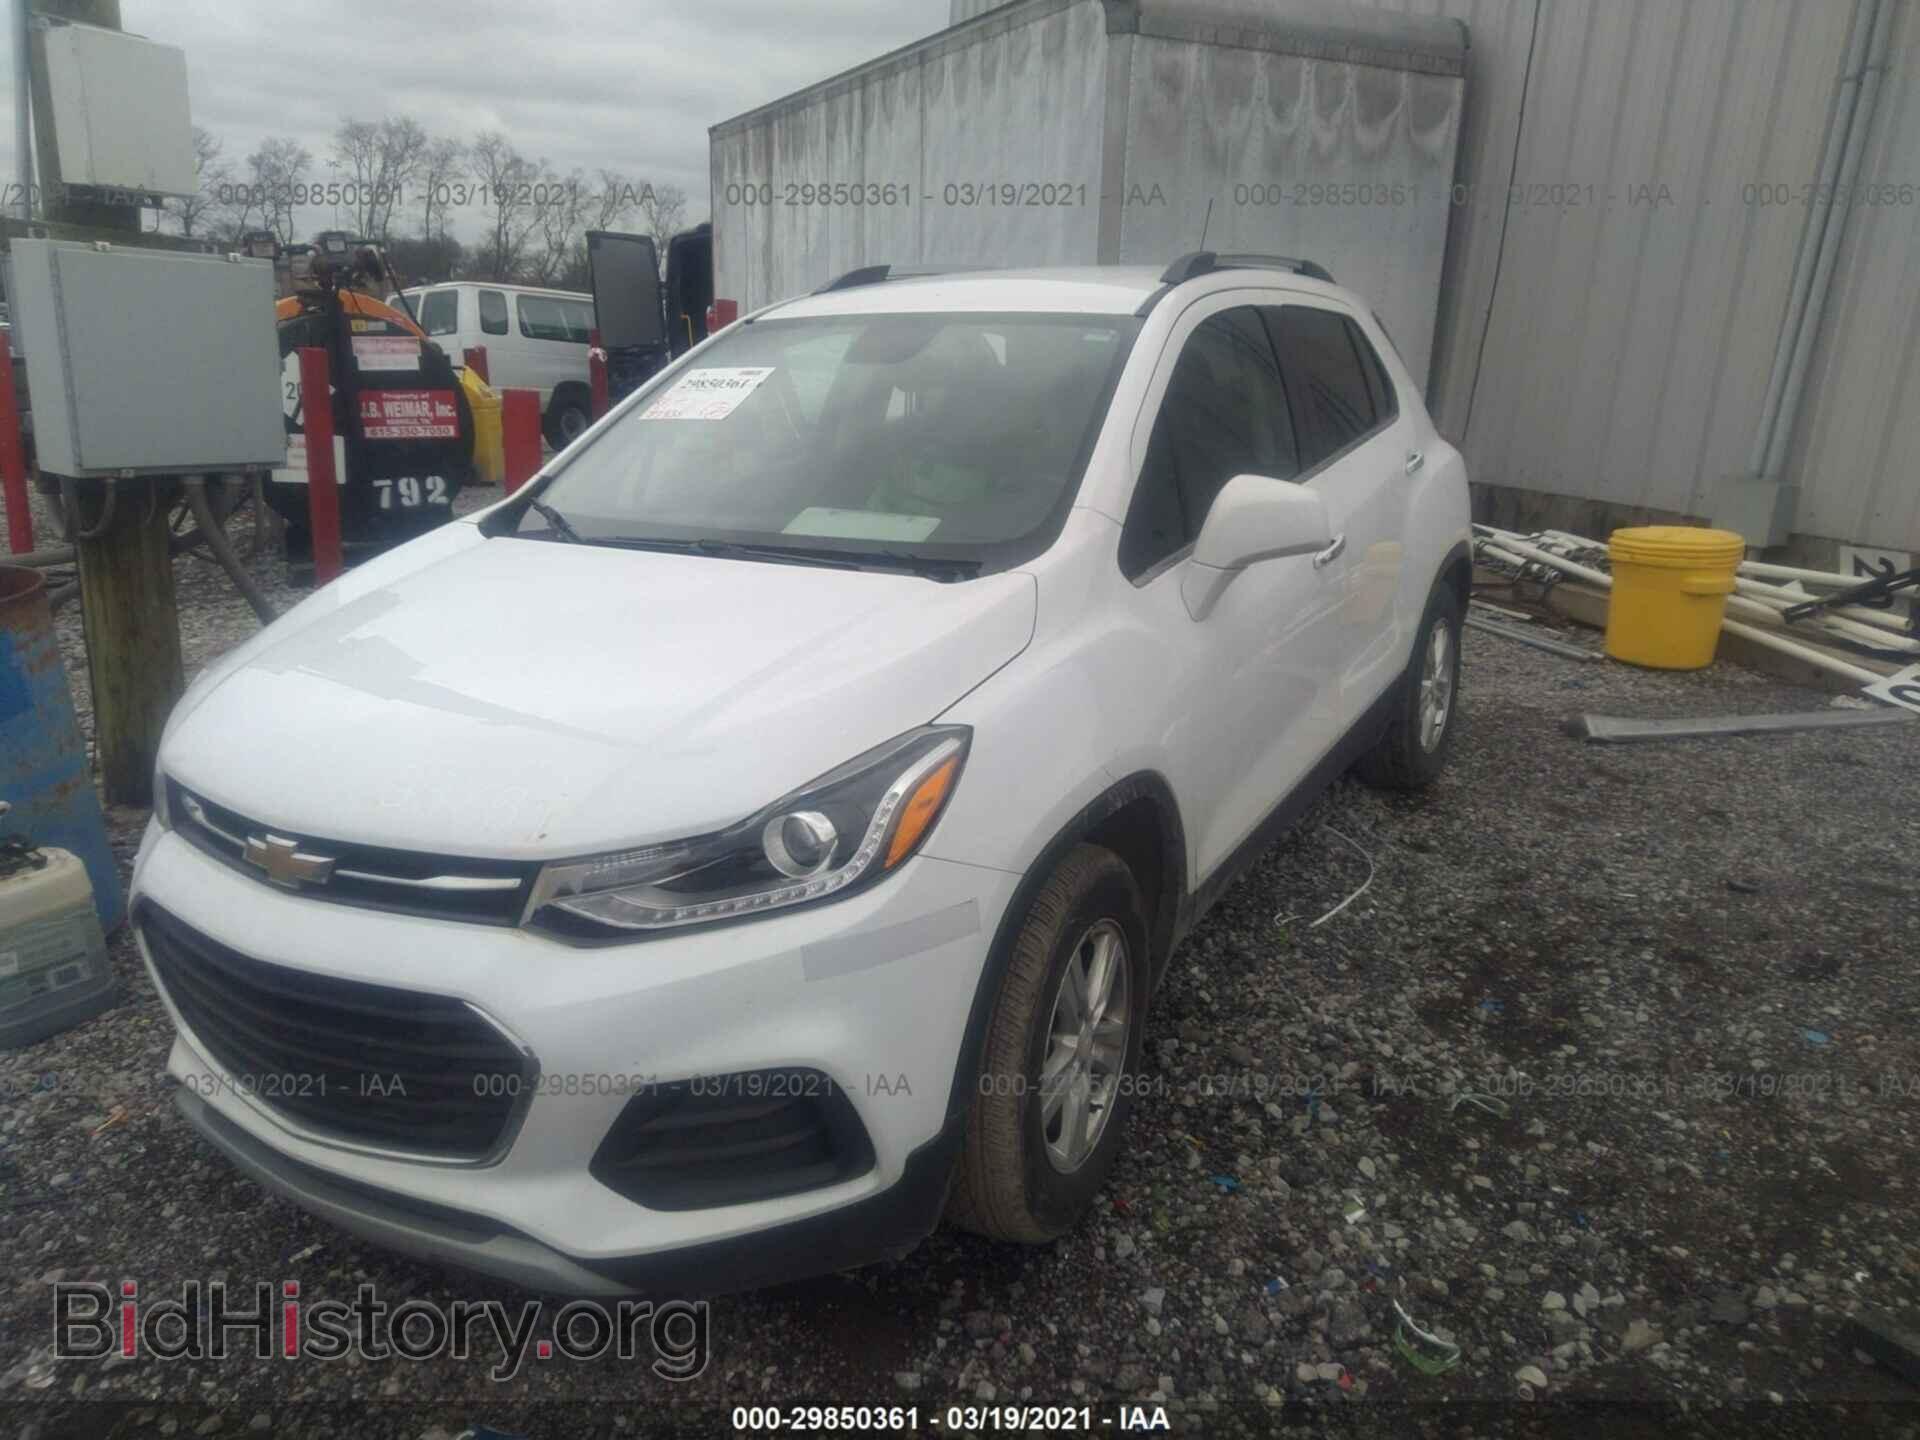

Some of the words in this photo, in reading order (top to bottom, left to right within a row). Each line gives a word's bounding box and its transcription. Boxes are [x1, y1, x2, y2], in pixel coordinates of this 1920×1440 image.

[383, 400, 434, 421] WEIMAR,
[435, 400, 457, 418] Inc.
[372, 475, 449, 509] 792
